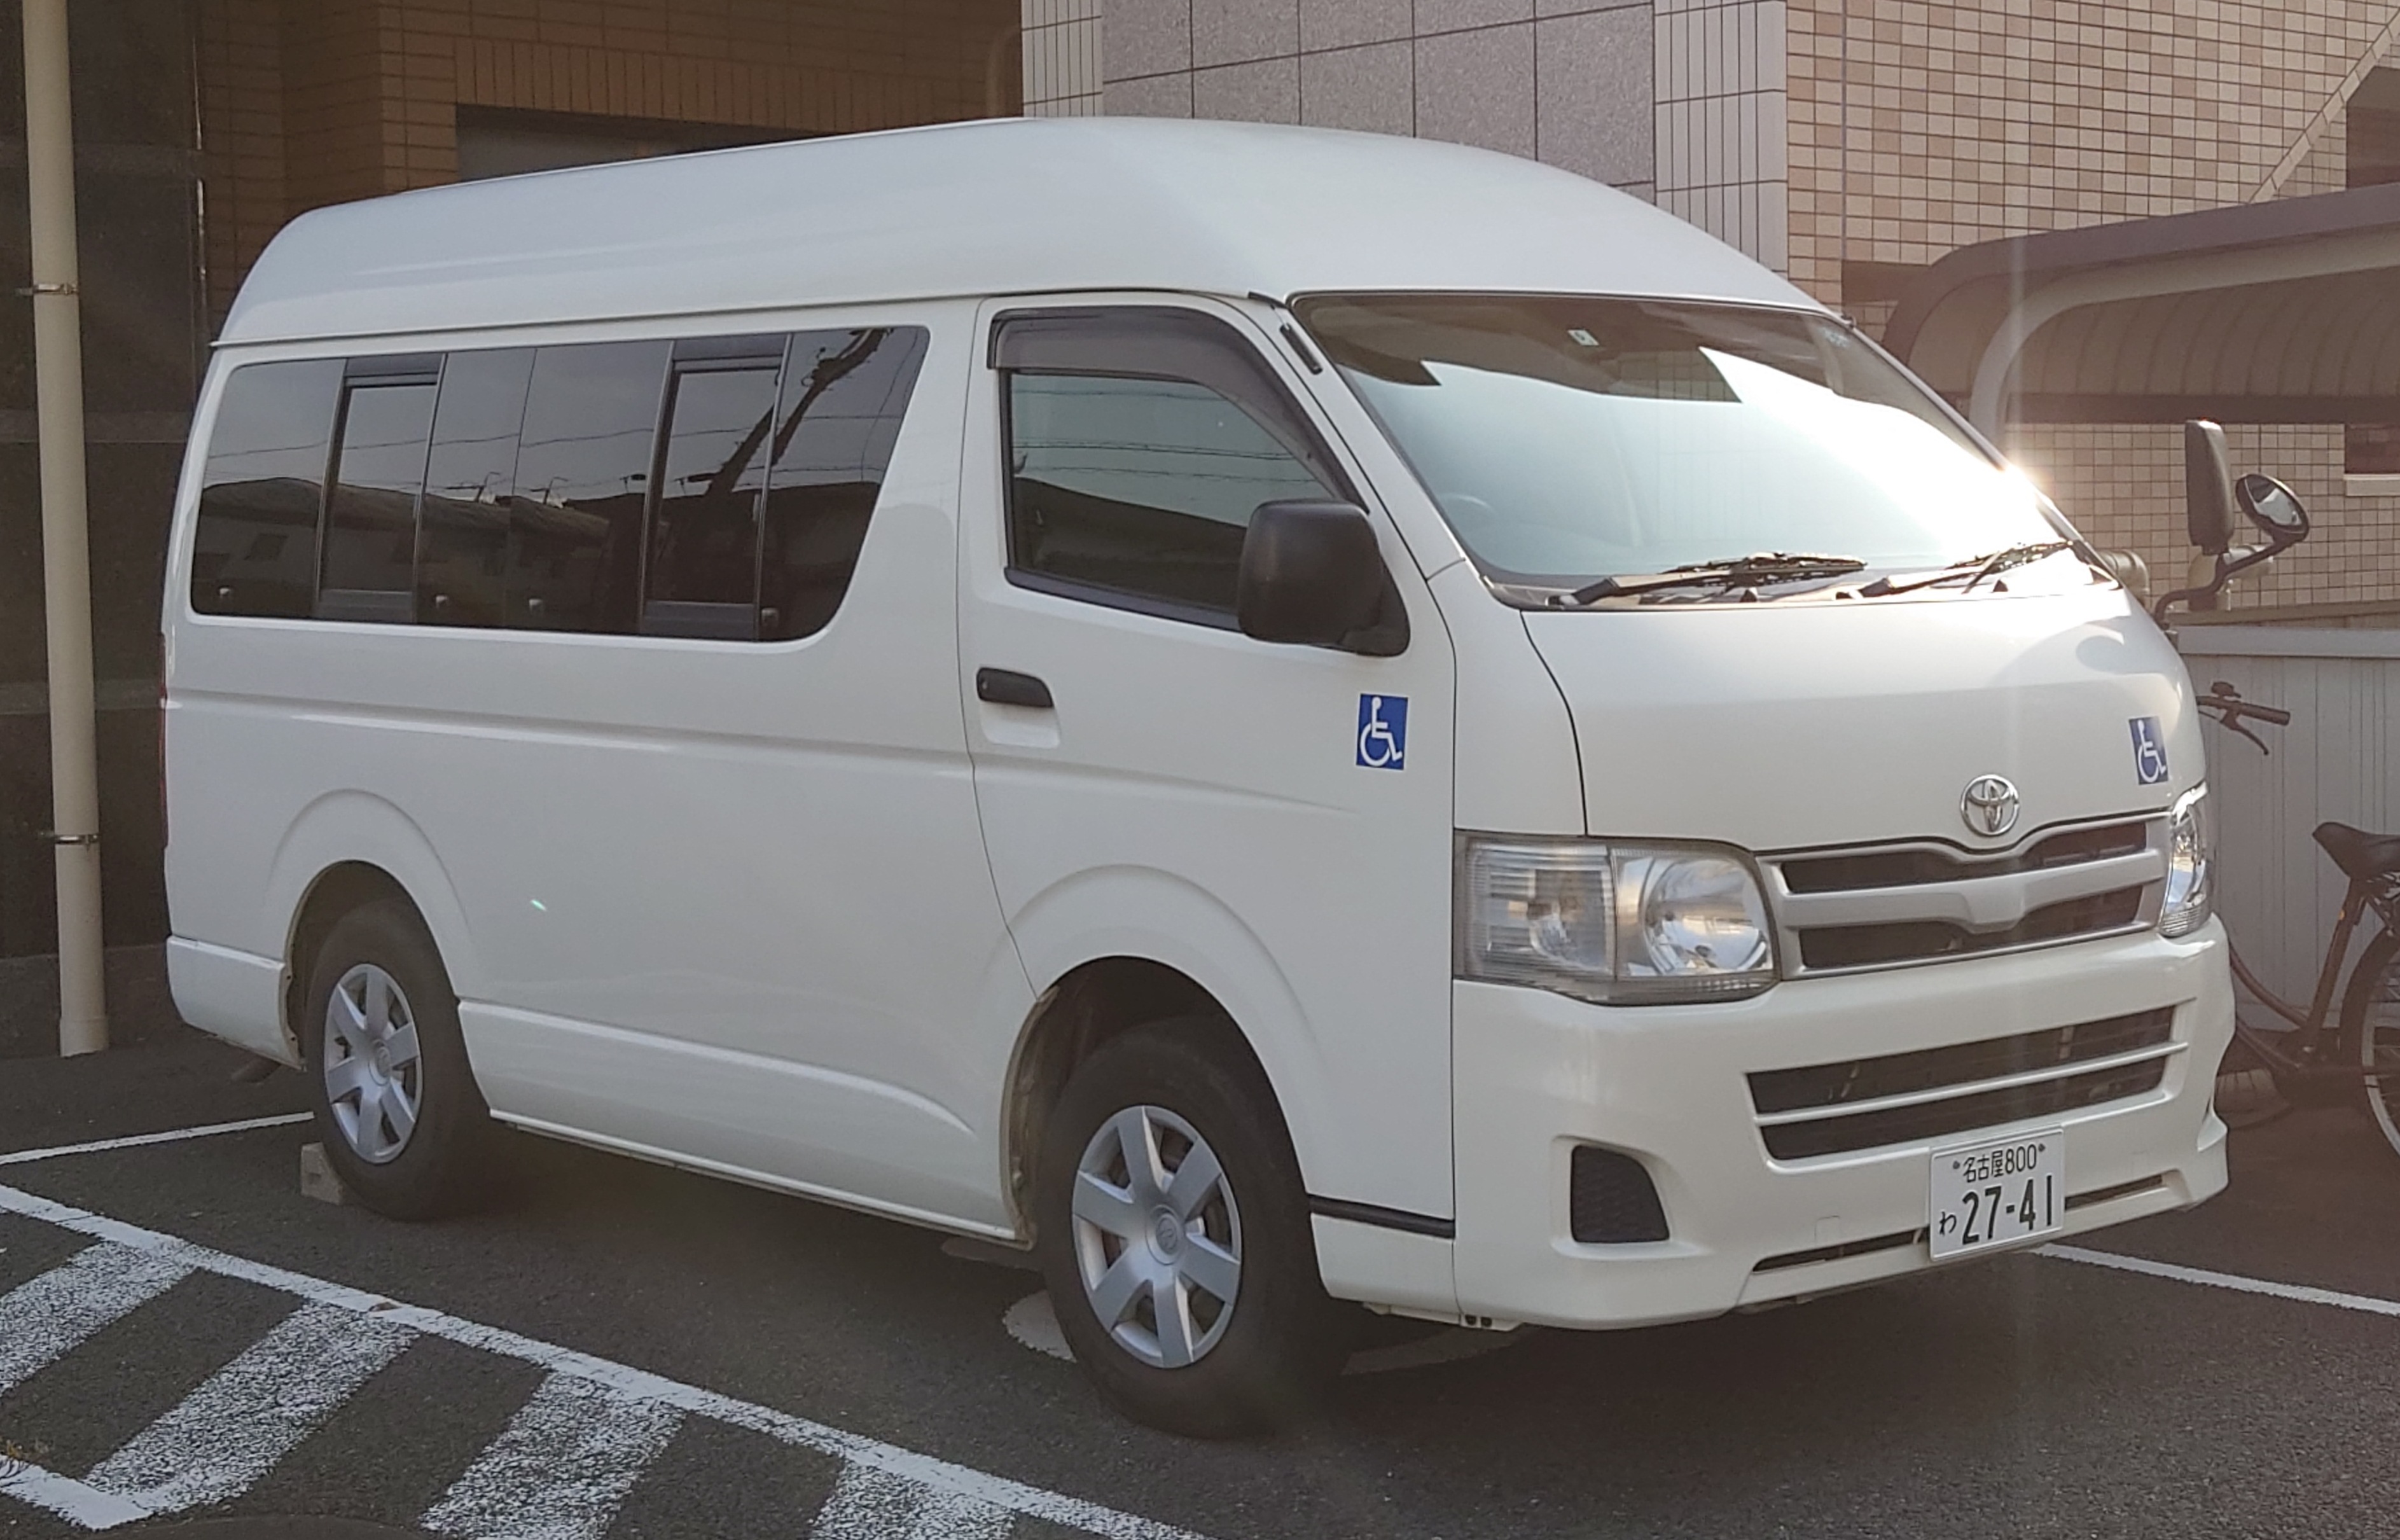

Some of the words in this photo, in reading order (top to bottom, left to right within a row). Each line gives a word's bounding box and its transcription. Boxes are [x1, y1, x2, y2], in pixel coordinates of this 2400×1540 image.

[1963, 1144, 2036, 1183] 名古屋800
[1939, 1211, 1957, 1236] わ
[1962, 1175, 2052, 1245] 27-41
